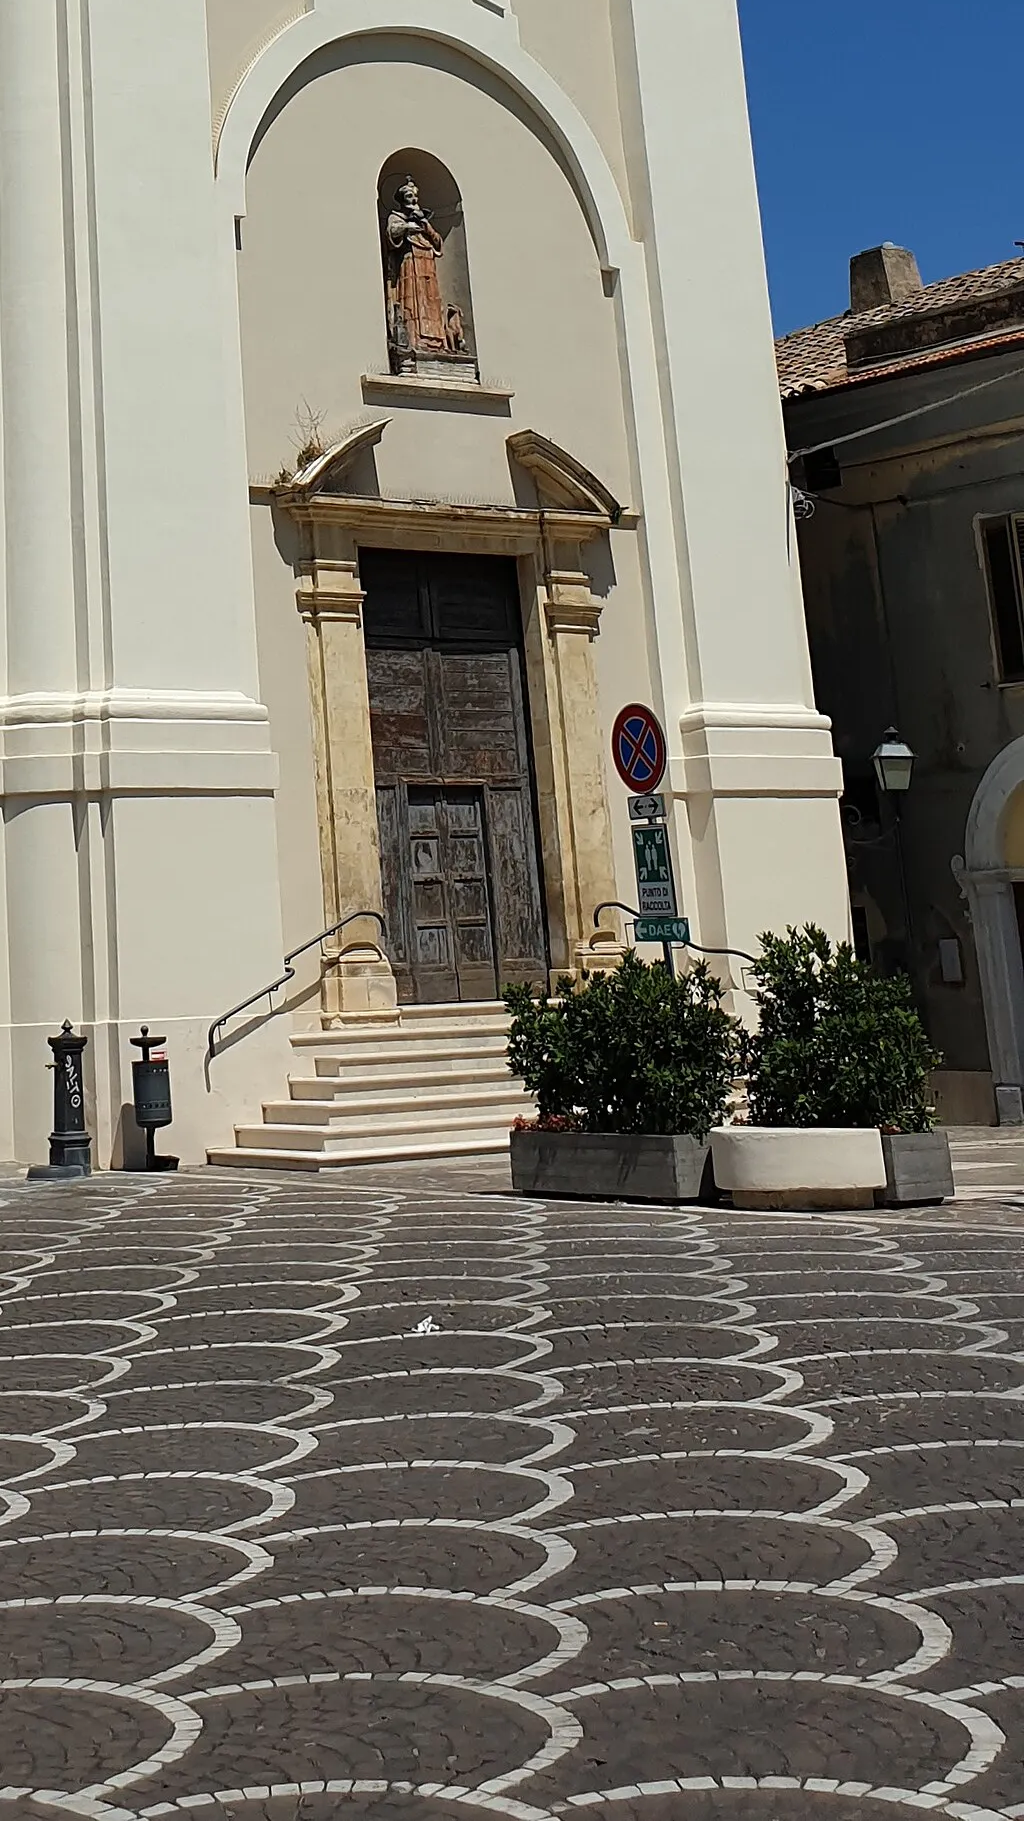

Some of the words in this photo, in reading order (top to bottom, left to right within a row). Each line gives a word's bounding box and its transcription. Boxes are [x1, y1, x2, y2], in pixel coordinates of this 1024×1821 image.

[642, 888, 661, 897] PUNTO
[662, 887, 668, 897] DI
[642, 901, 671, 911] RACCOLTA
[648, 924, 672, 936] DAE
